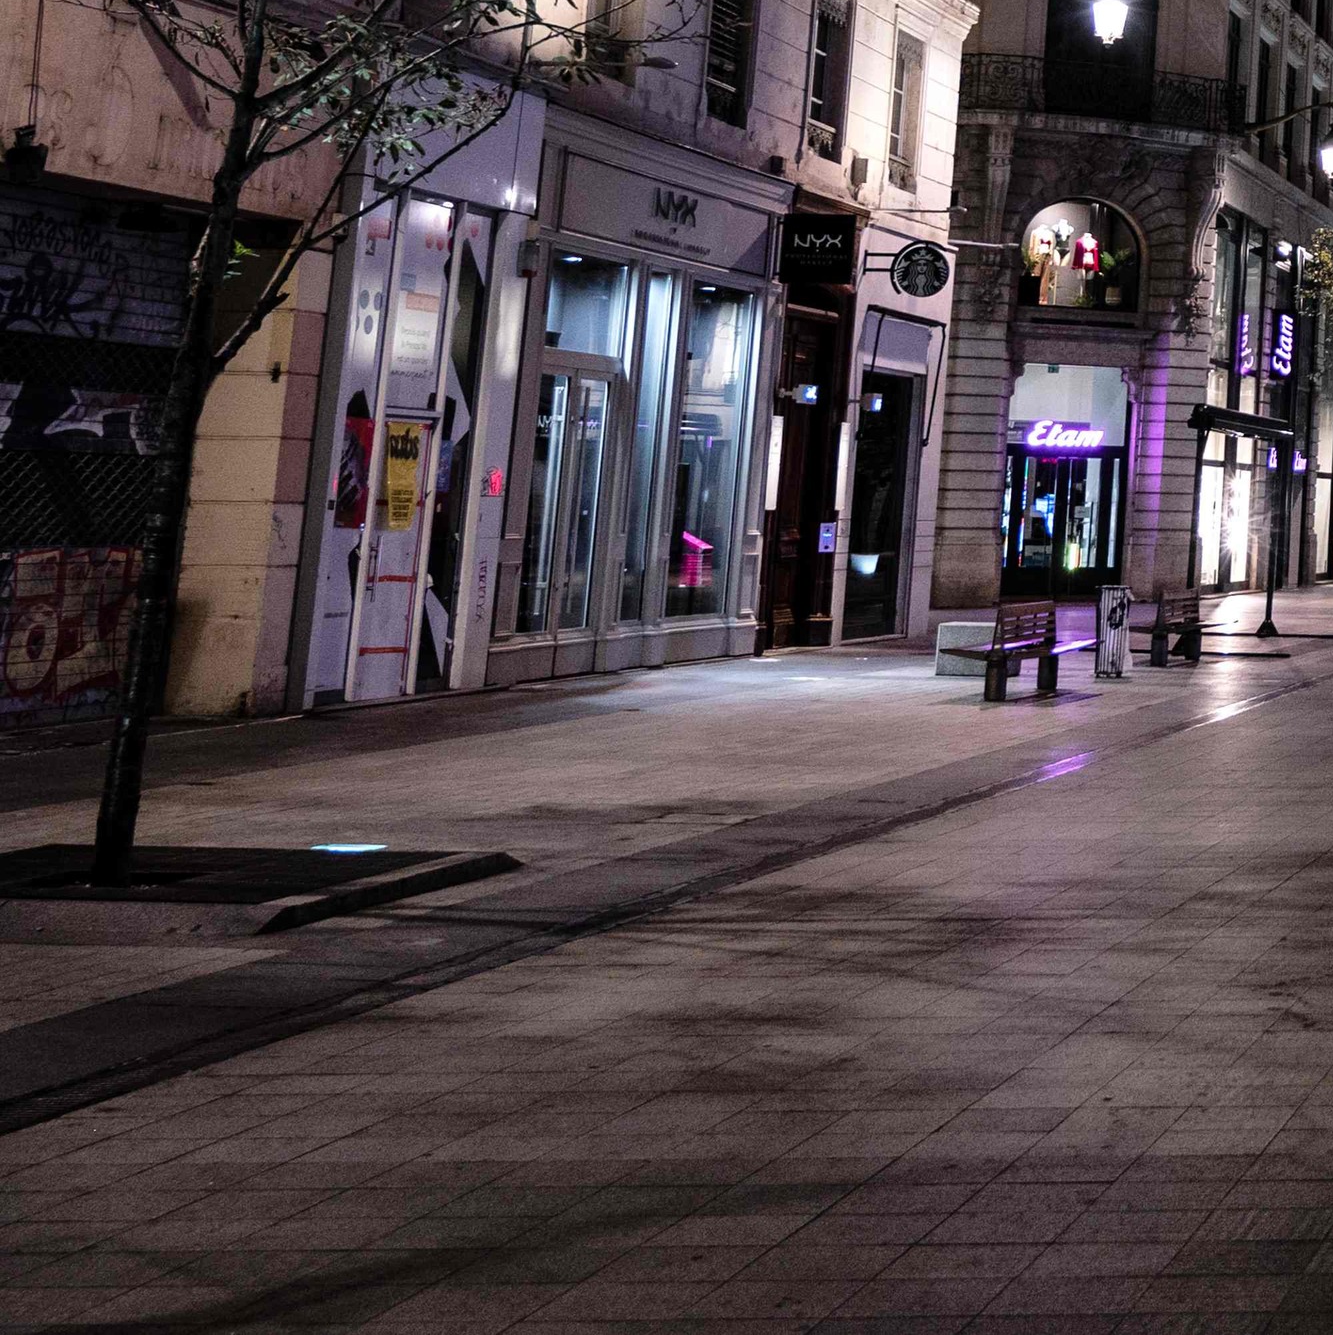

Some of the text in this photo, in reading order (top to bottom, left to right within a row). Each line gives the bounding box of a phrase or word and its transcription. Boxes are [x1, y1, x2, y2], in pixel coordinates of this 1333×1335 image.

[651, 187, 699, 227] NYX
[793, 233, 843, 248] NYX
[1271, 314, 1294, 377] Etam
[1027, 420, 1105, 448] Etam
